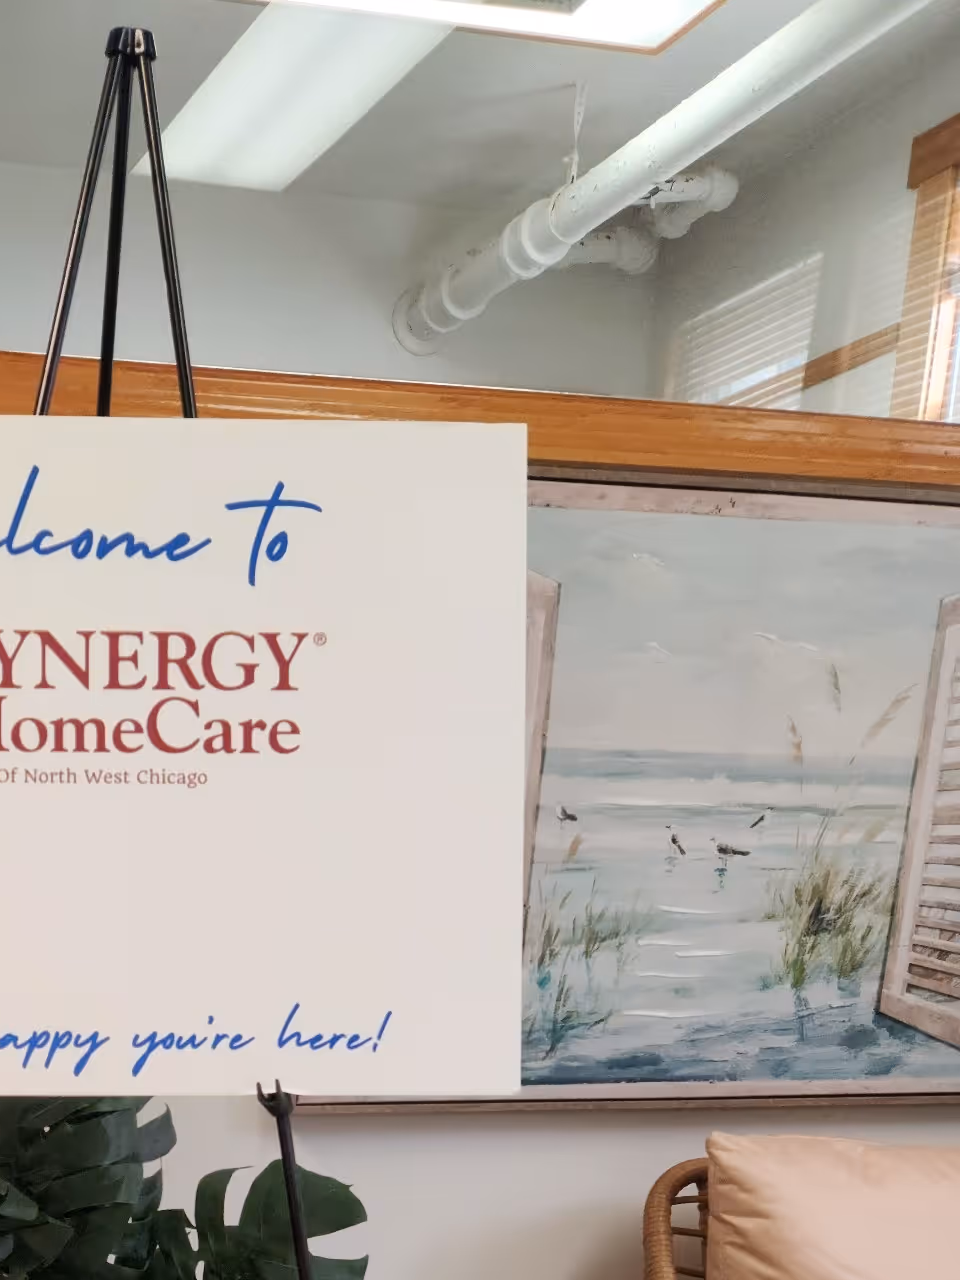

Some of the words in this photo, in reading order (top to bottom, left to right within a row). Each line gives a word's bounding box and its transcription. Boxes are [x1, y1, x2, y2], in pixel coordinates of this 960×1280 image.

[25, 767, 77, 784] North
[84, 769, 129, 785] West
[136, 768, 208, 788] Chicago
[131, 1015, 256, 1077] you're
[277, 1002, 393, 1053] here!
